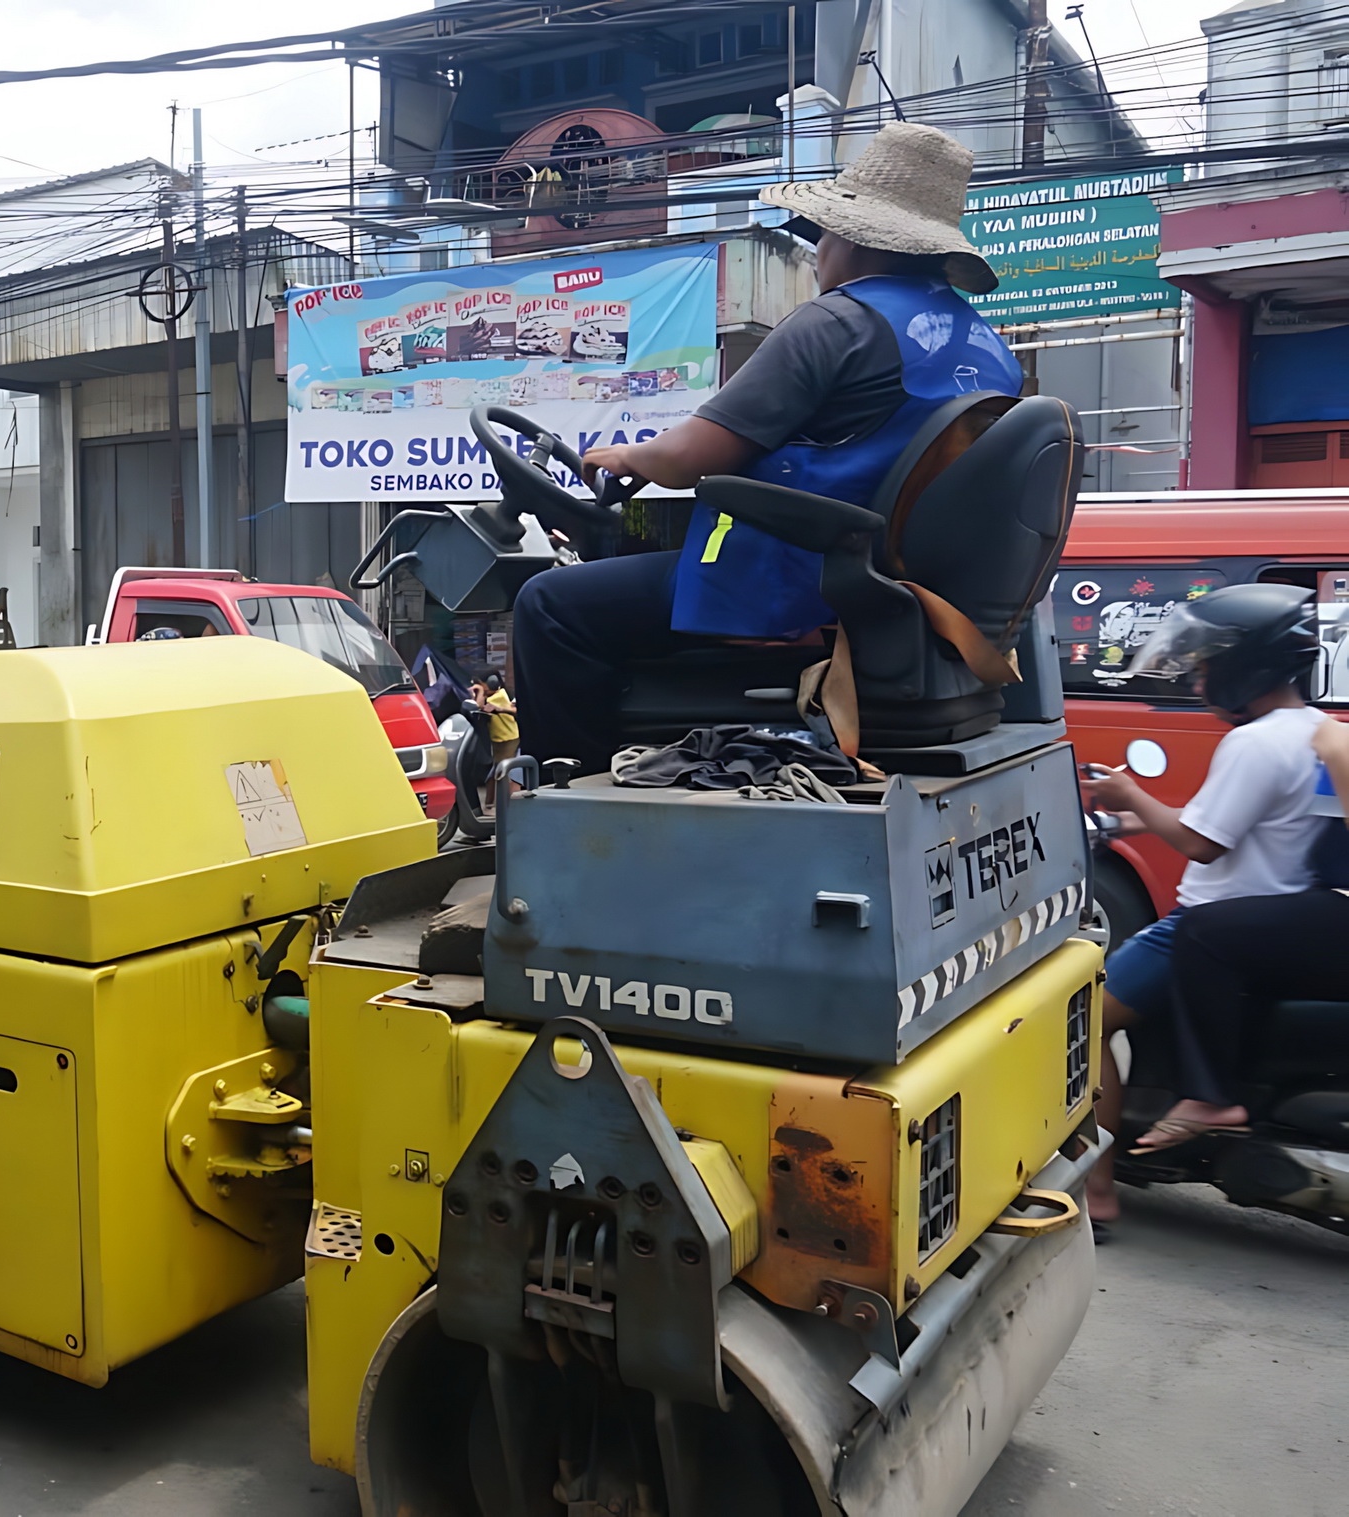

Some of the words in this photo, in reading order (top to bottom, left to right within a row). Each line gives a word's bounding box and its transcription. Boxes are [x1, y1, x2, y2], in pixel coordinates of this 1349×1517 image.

[294, 289, 326, 318] POP
[300, 439, 393, 468] TOKO
[370, 473, 473, 491] SEMBAKO
[958, 811, 1046, 900] TEREX
[525, 968, 733, 1026] TV1400
